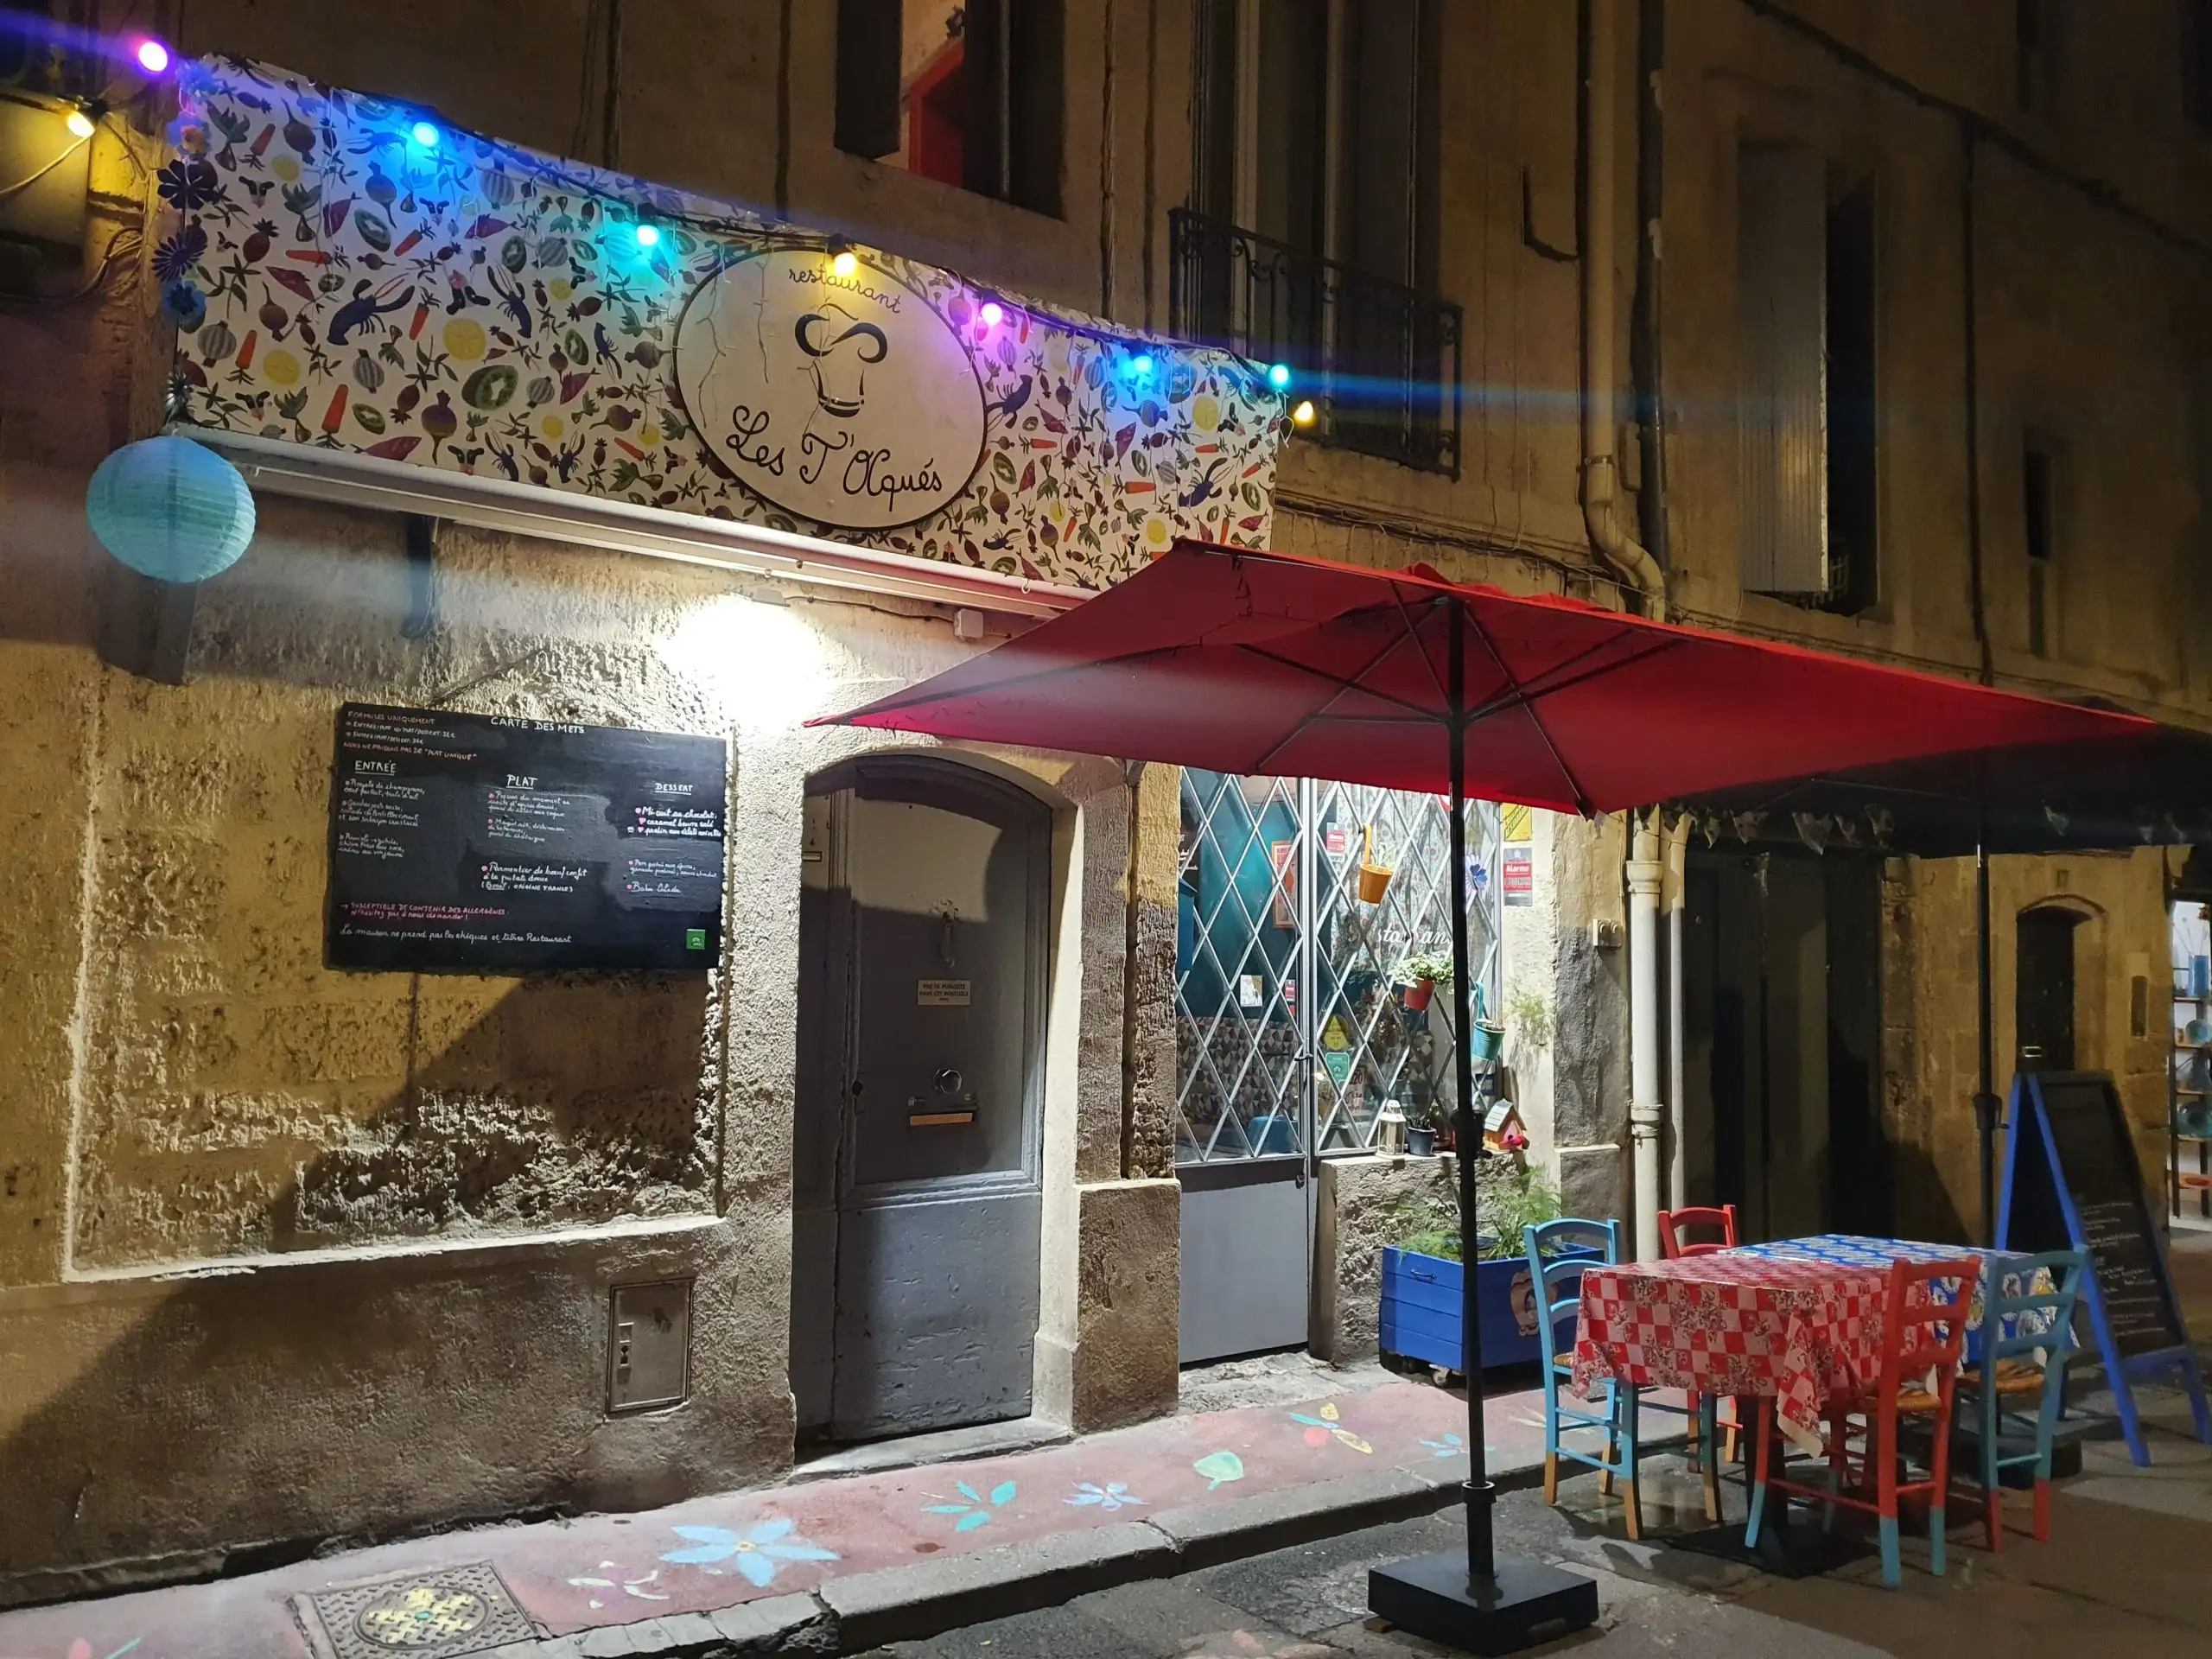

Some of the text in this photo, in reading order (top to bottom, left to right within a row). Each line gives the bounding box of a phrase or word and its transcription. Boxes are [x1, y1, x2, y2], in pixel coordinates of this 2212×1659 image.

[787, 264, 900, 314] restaurant
[725, 404, 785, 476] Les
[387, 715, 435, 725] UNIQUEMENT
[491, 716, 585, 734] CARTE DES METS
[354, 760, 397, 773] ENTRÉE
[506, 774, 538, 786] PLAT
[655, 782, 693, 793] DESSERT
[1506, 864, 1529, 873] Alarme
[448, 906, 461, 914] DES
[525, 932, 572, 943] Restaurant
